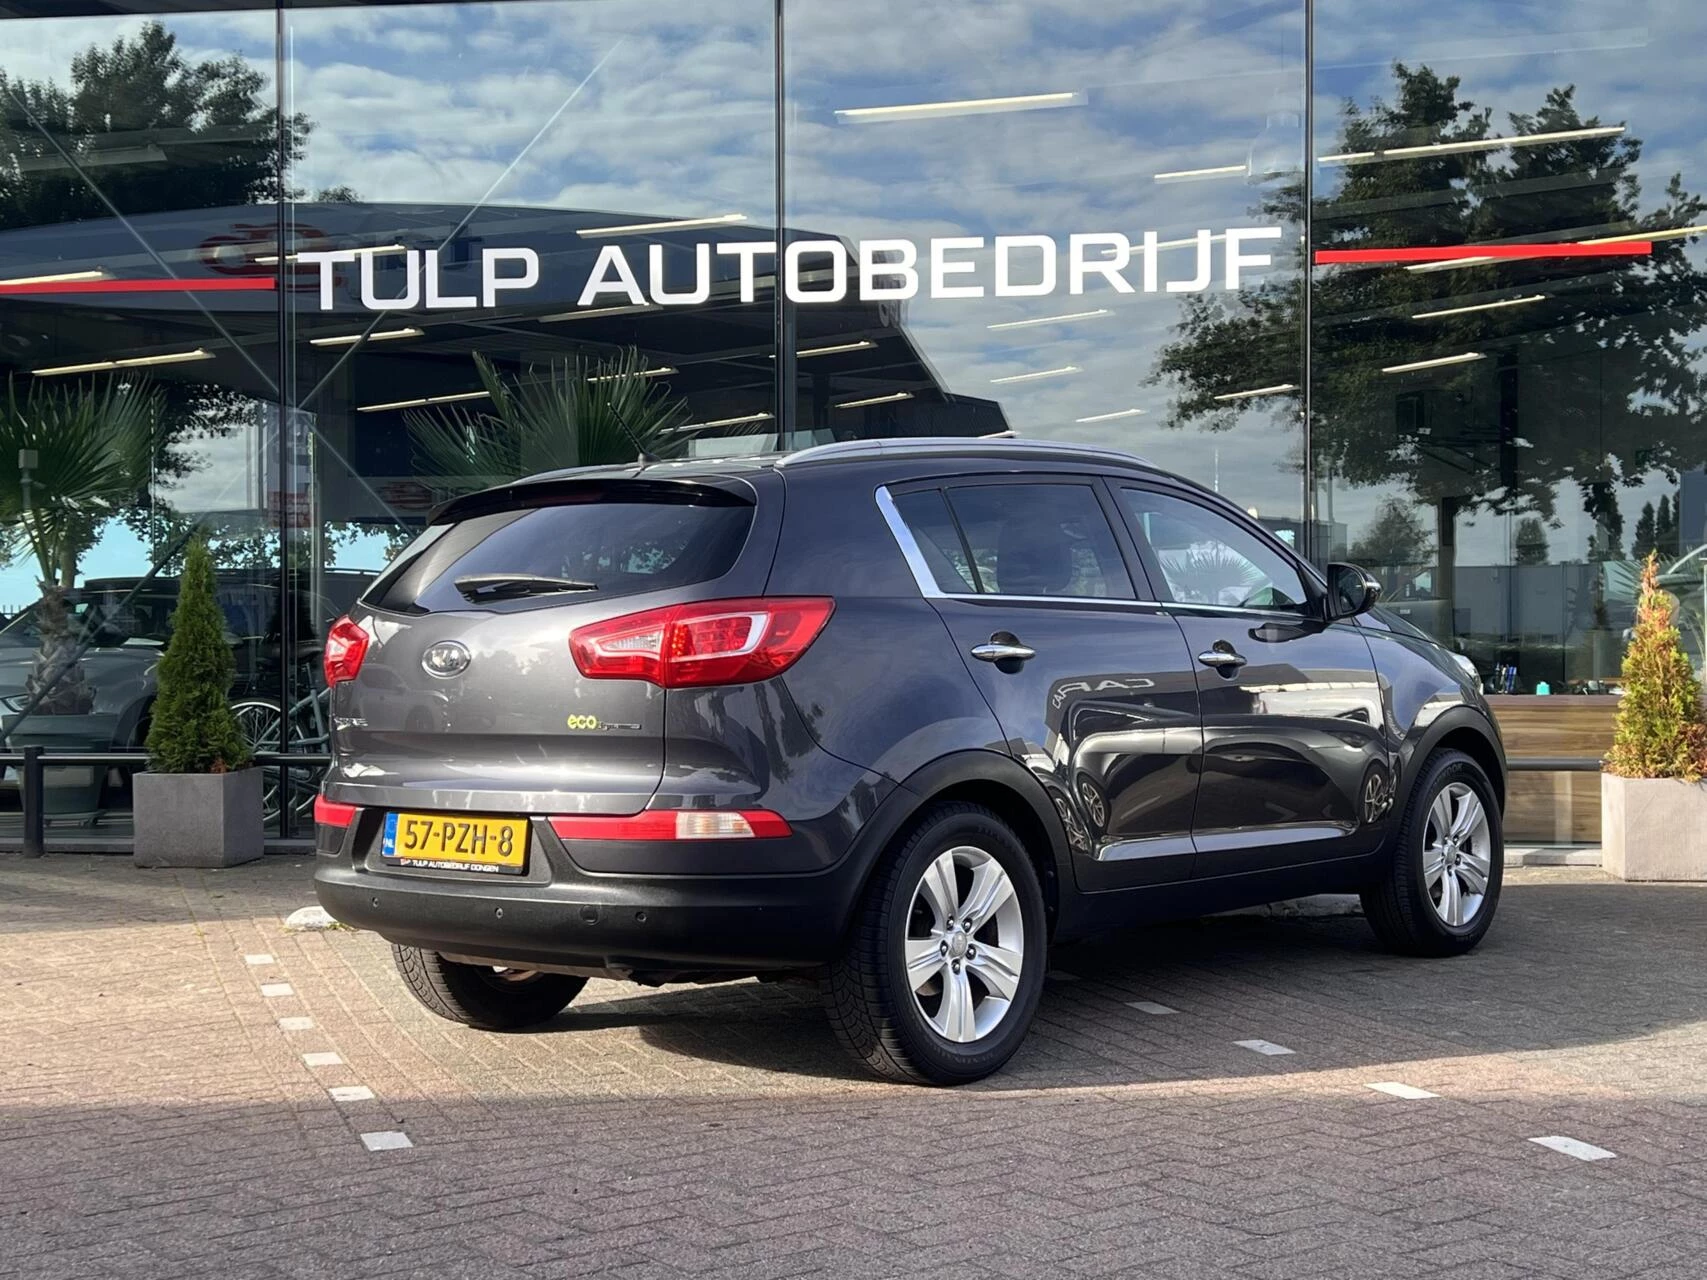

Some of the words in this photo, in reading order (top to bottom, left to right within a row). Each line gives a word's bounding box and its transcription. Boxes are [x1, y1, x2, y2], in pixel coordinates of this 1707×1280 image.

[298, 247, 539, 311] TULP
[577, 226, 1282, 310] AUTOBEDRIJF
[567, 713, 597, 730] eco
[403, 819, 514, 857] 57-PZH-8
